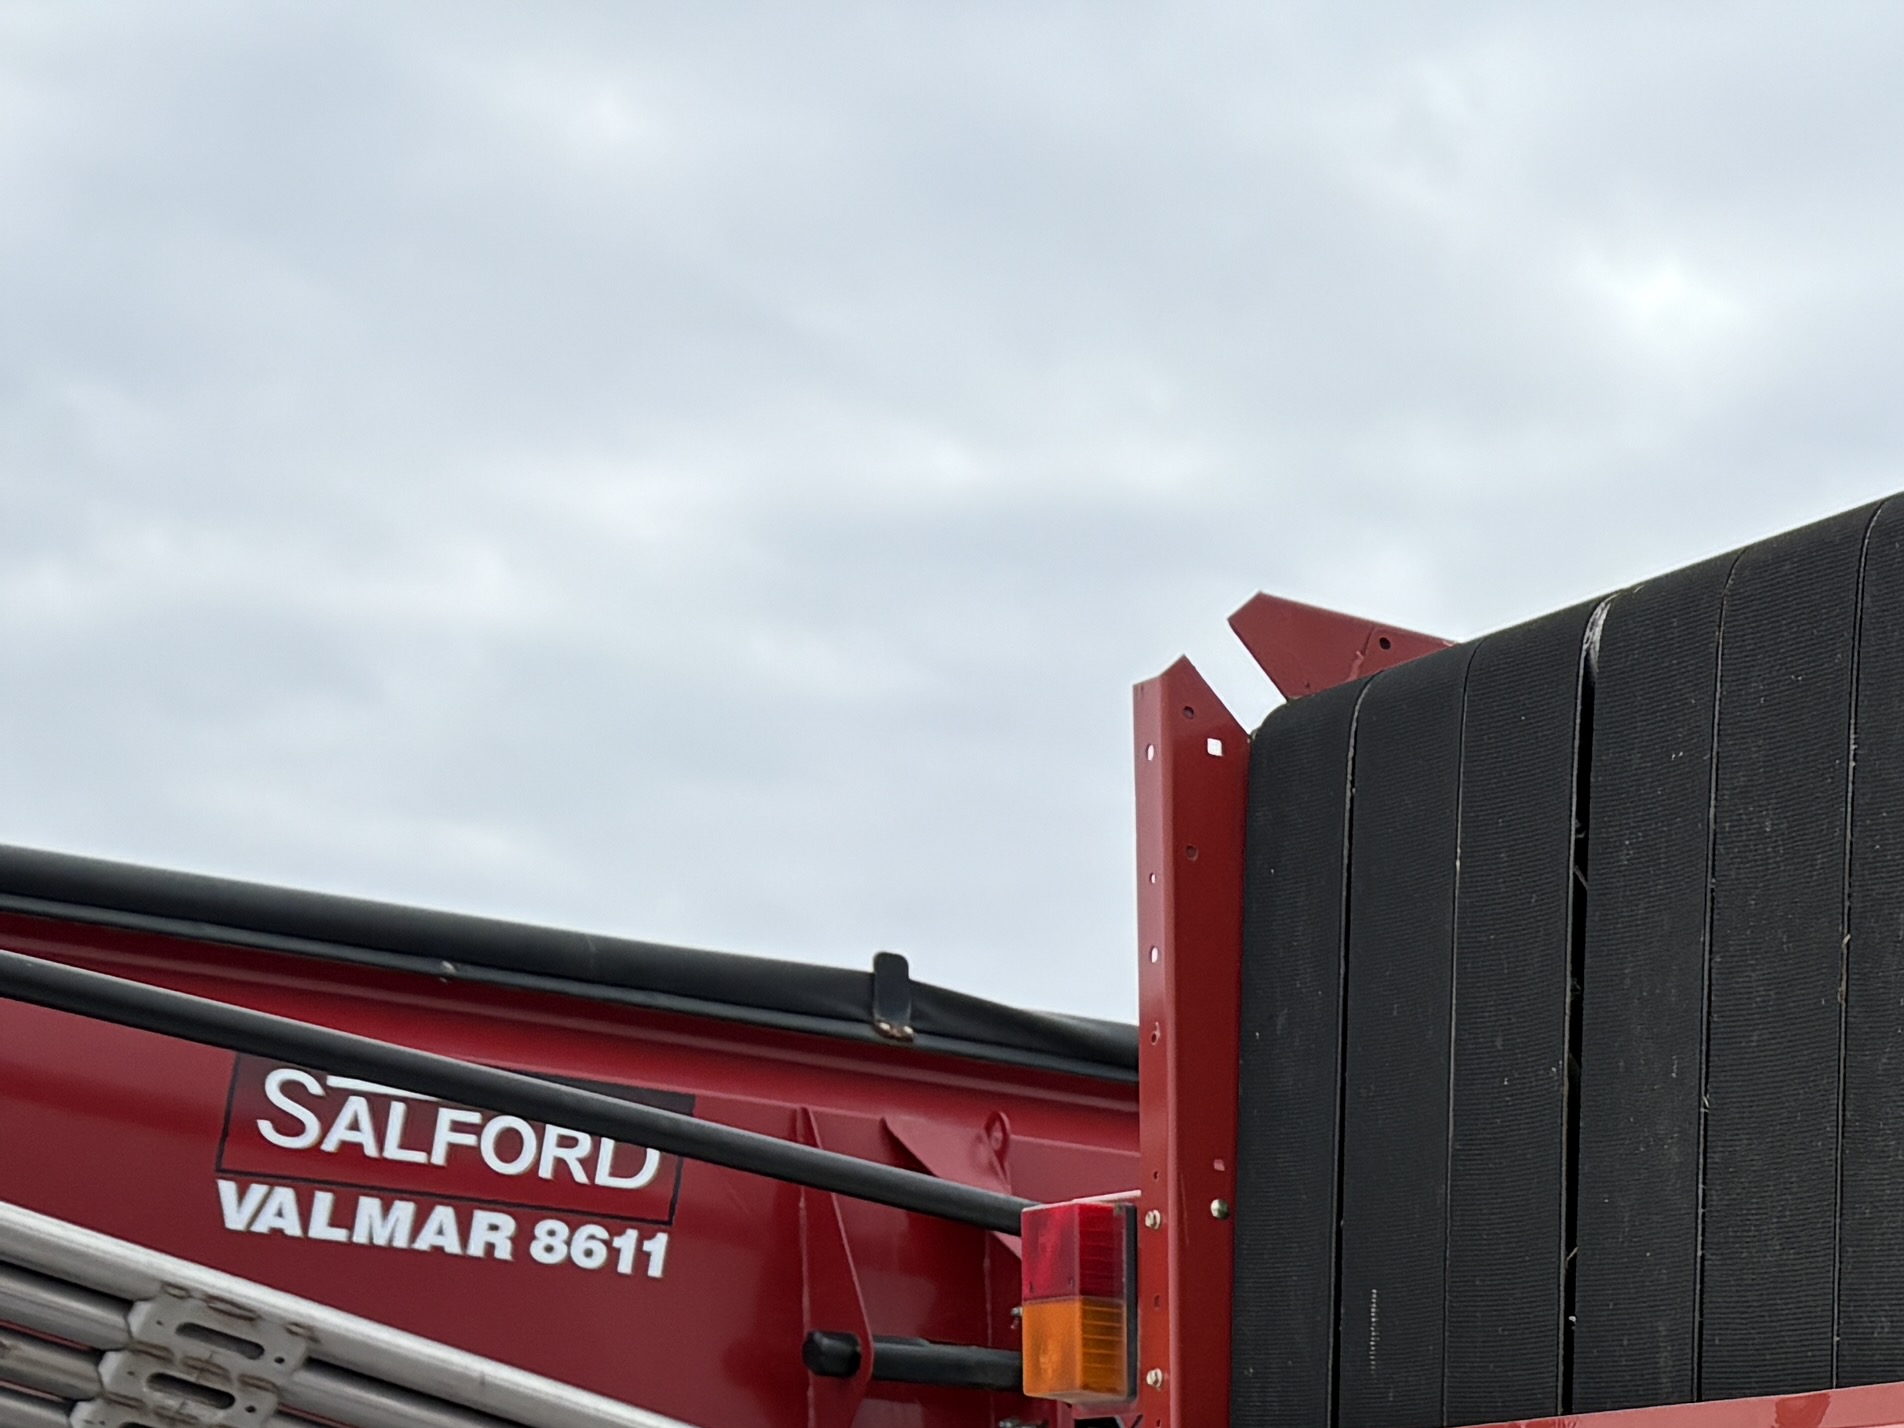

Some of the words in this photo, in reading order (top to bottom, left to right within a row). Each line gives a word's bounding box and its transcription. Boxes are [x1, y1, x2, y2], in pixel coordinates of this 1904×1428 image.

[256, 1067, 663, 1191] SALFORD
[216, 1179, 517, 1262] VALMAR
[529, 1224, 670, 1279] 8611
